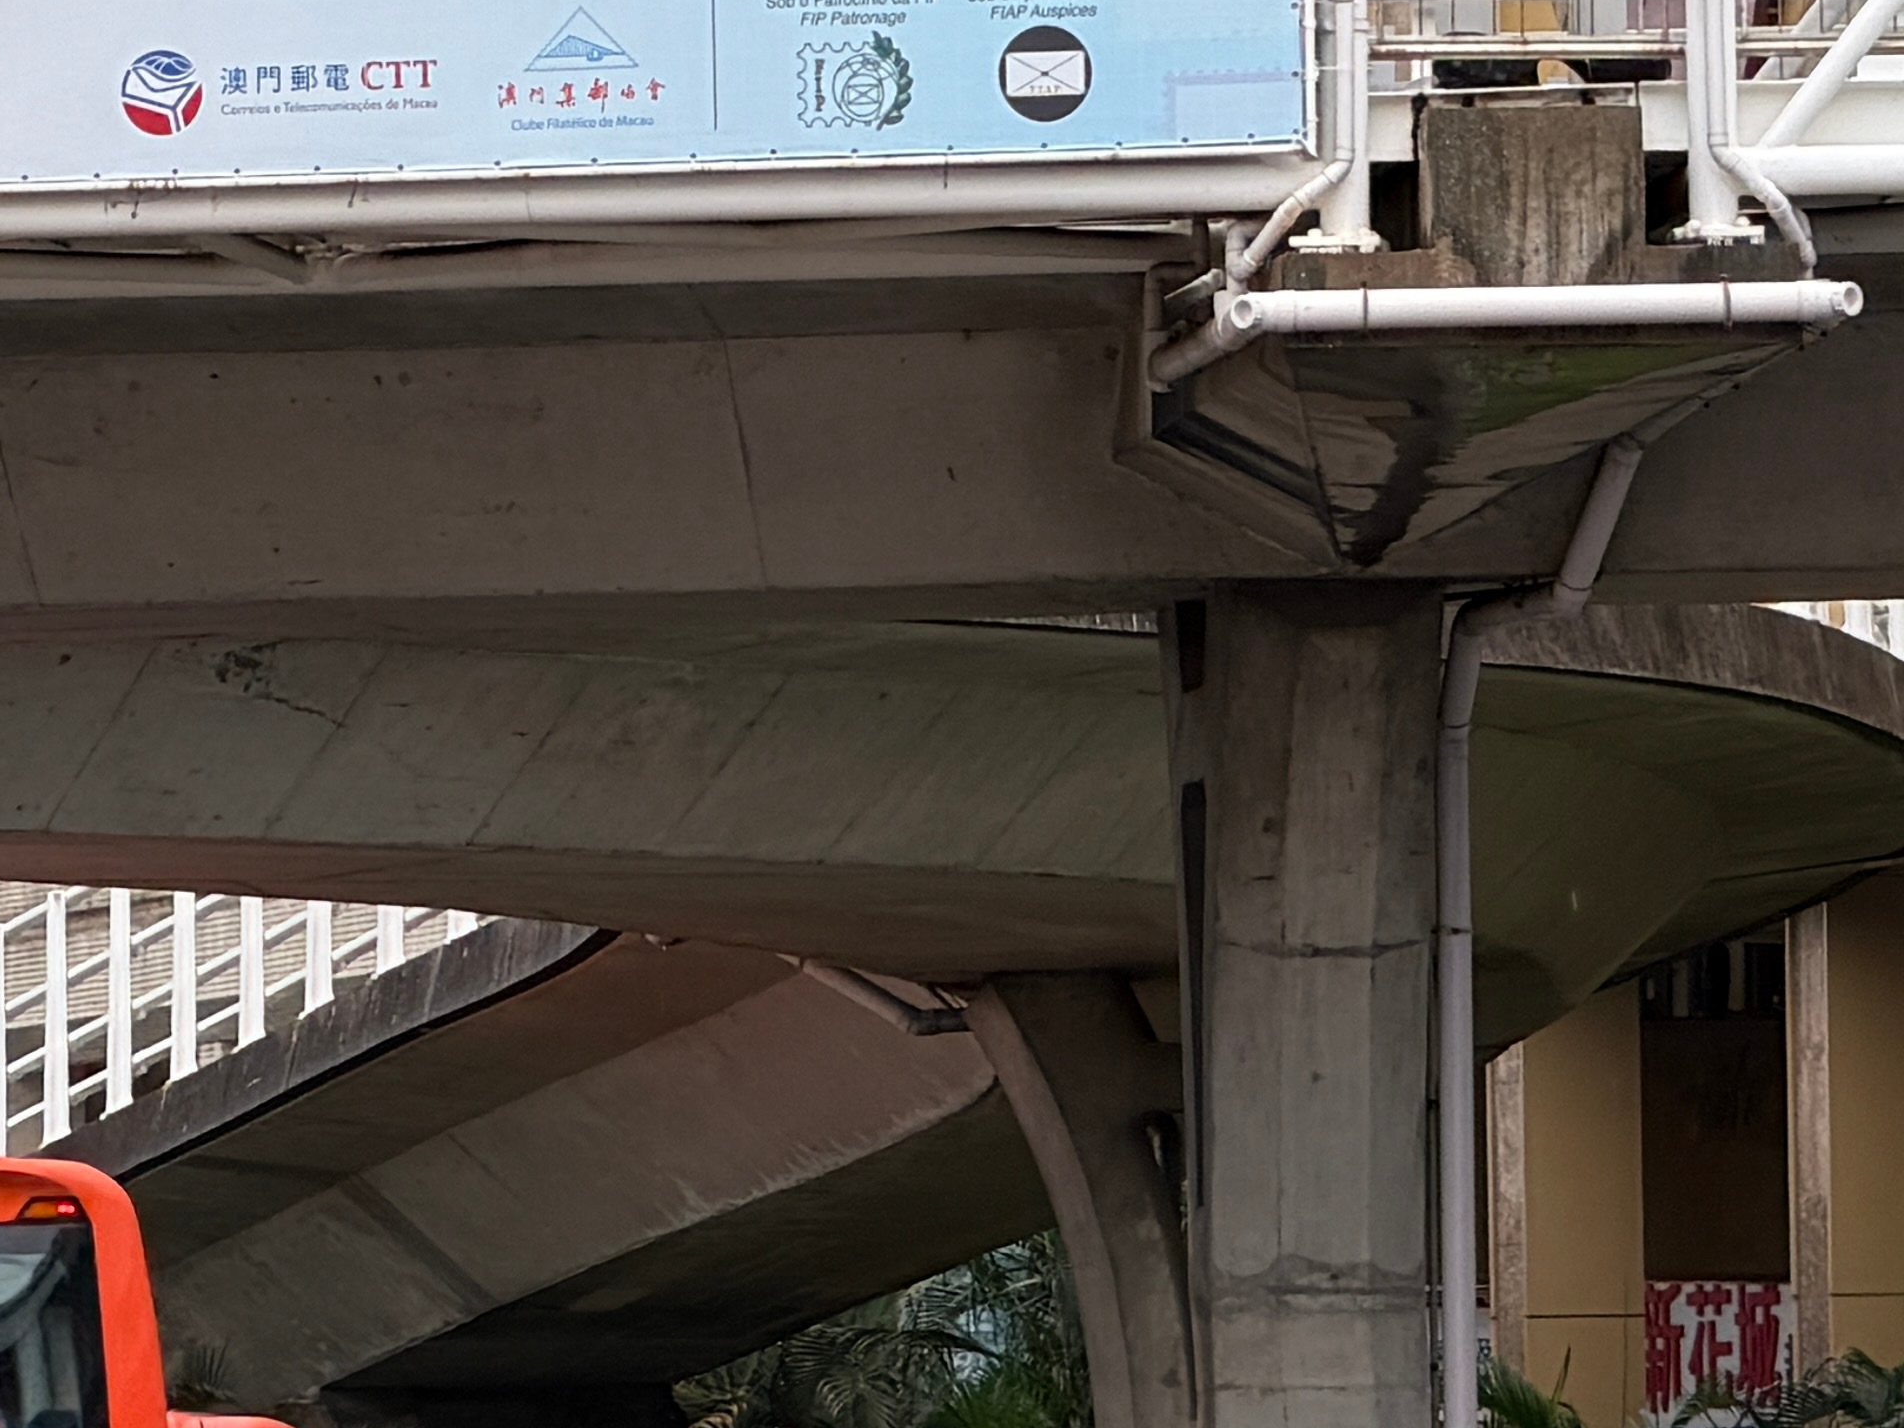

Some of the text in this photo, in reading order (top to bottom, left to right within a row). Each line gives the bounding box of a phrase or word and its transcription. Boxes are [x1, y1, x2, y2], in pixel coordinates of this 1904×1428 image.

[800, 10, 907, 28] FIP Patronage
[990, 3, 1098, 20] FIAP Auspices
[220, 59, 438, 95] 澳門郵電 CTT
